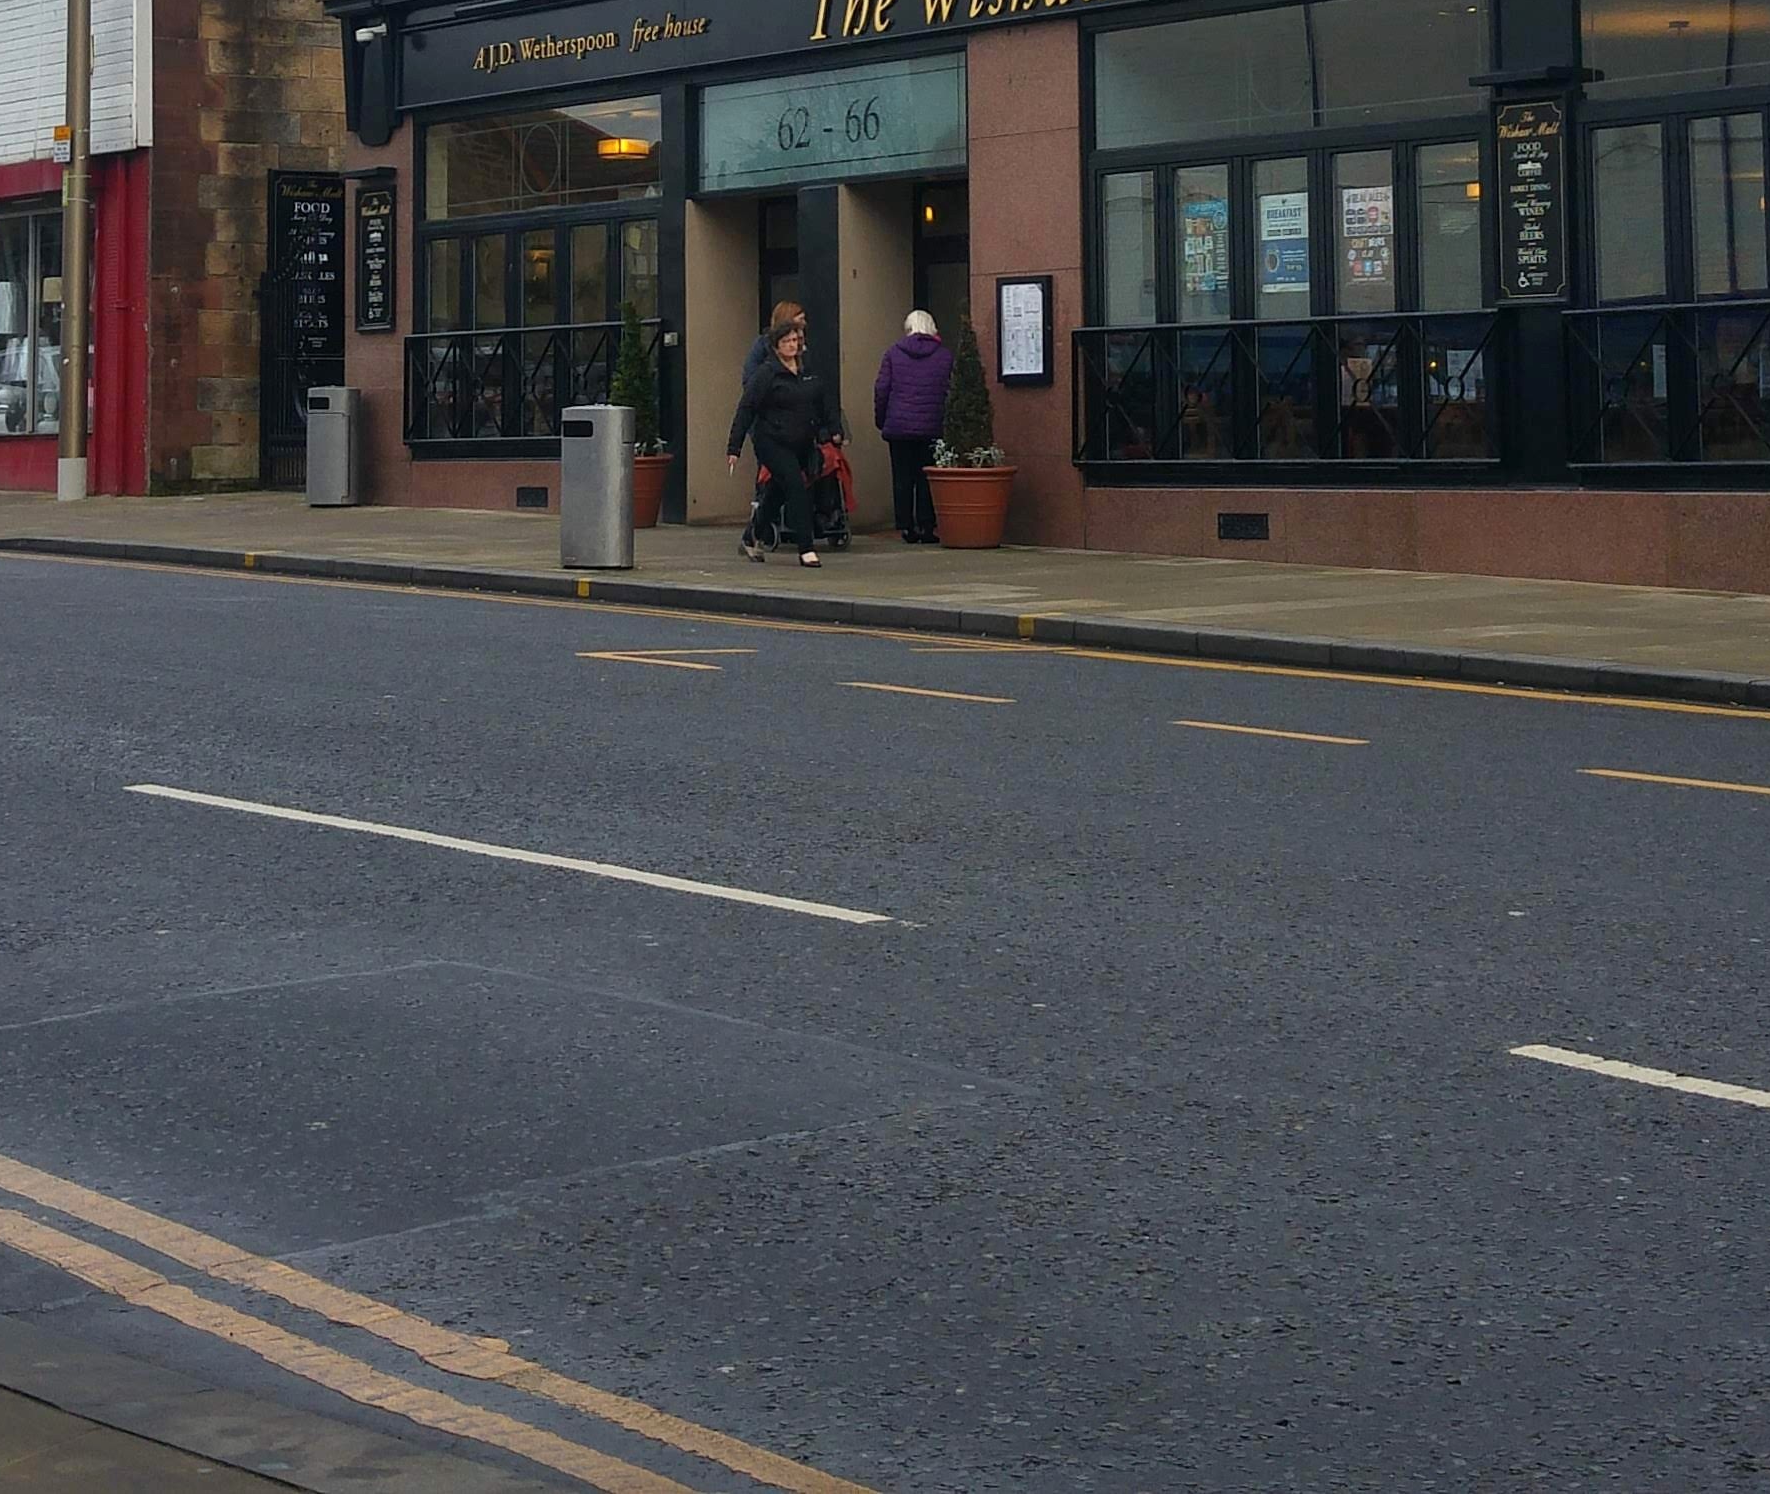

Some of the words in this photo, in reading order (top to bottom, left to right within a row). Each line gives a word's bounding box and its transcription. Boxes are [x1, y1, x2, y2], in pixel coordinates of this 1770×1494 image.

[473, 47, 485, 70] A
[519, 31, 617, 60] Wetherspoon
[629, 17, 658, 53] free
[664, 13, 706, 39] house
[778, 106, 811, 151] 62
[845, 95, 880, 143] 66
[1517, 141, 1542, 153] FOOD
[293, 201, 331, 213] FOOD
[1266, 207, 1302, 219] BREAKFAST
[1518, 207, 1544, 216] WINES
[1517, 254, 1548, 265] SPIRITS
